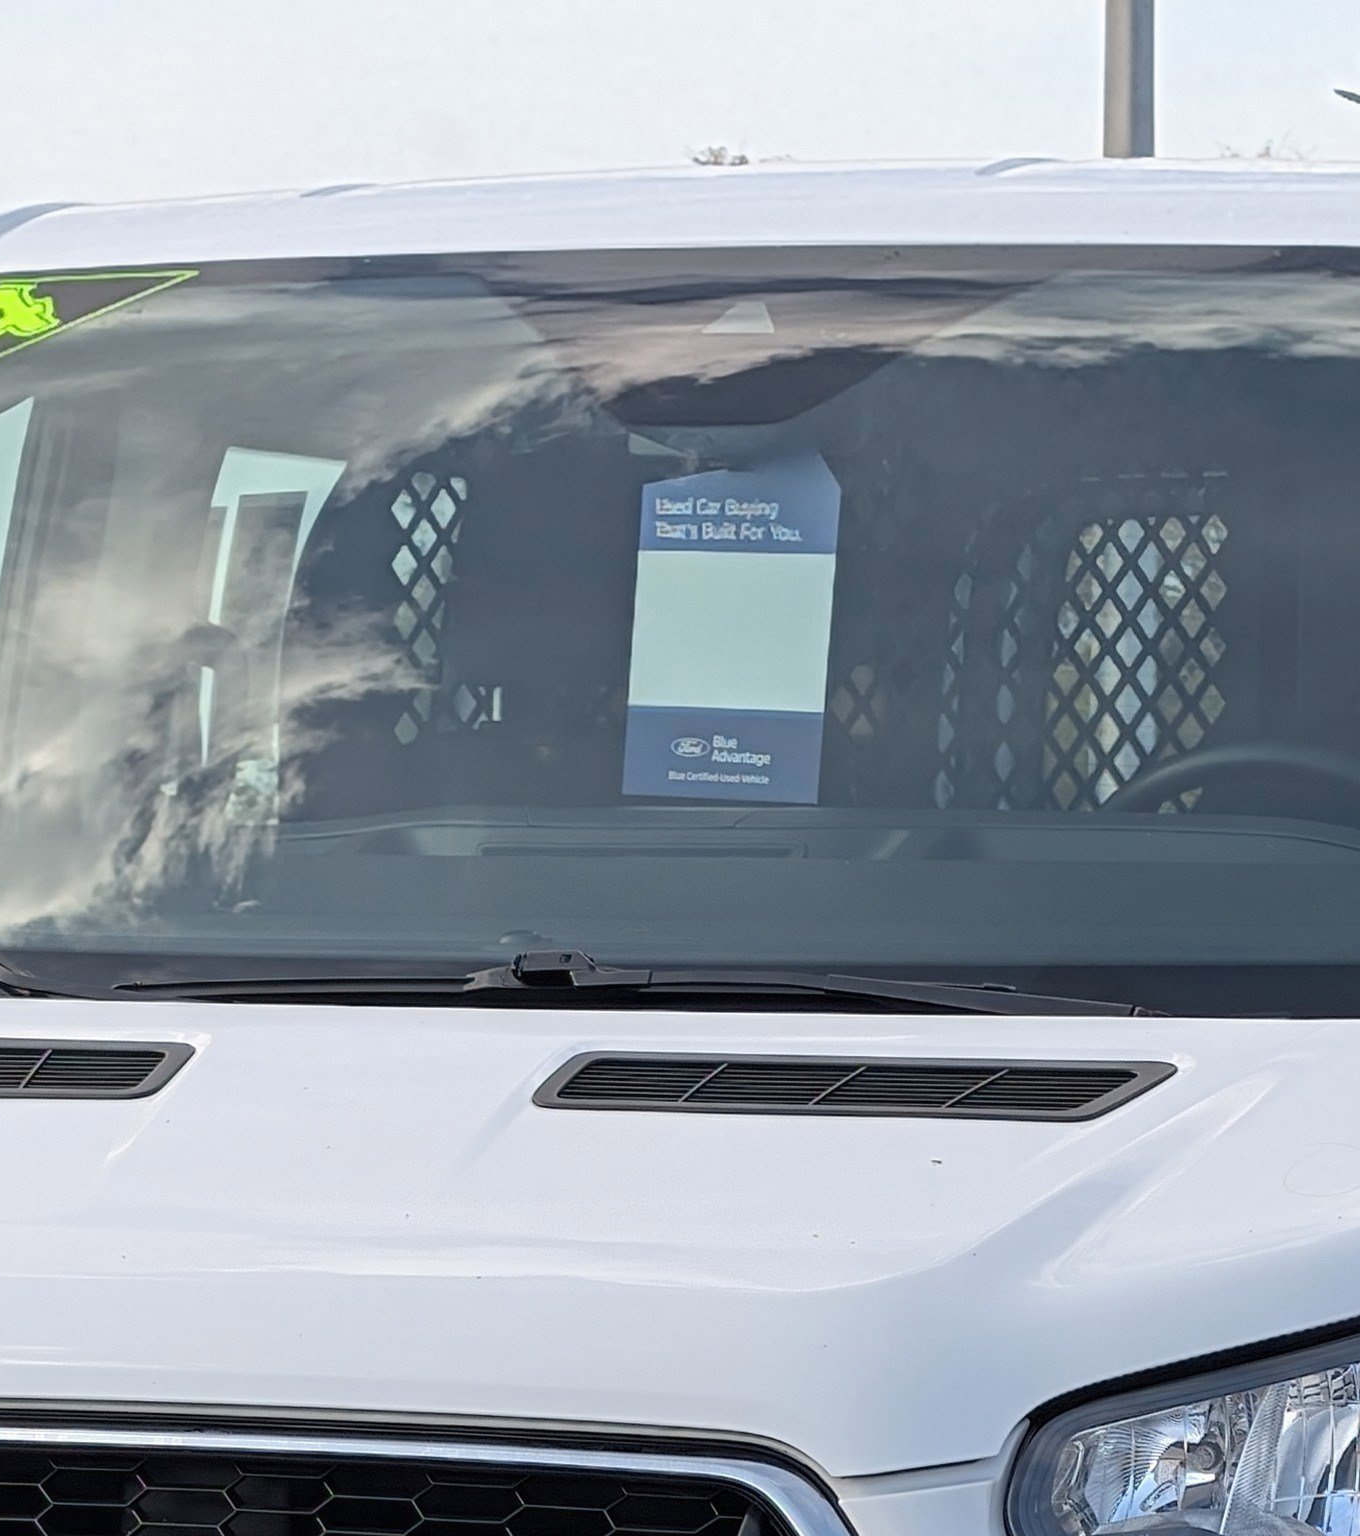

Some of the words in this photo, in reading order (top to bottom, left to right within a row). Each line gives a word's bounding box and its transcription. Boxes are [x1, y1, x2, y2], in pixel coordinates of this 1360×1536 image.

[655, 497, 693, 515] Used
[696, 498, 722, 515] Car
[725, 497, 779, 520] Buying
[702, 522, 737, 540] Built
[740, 522, 766, 541] For
[712, 735, 738, 749] Blue
[711, 749, 771, 767] Advantage
[668, 770, 686, 780] Blue
